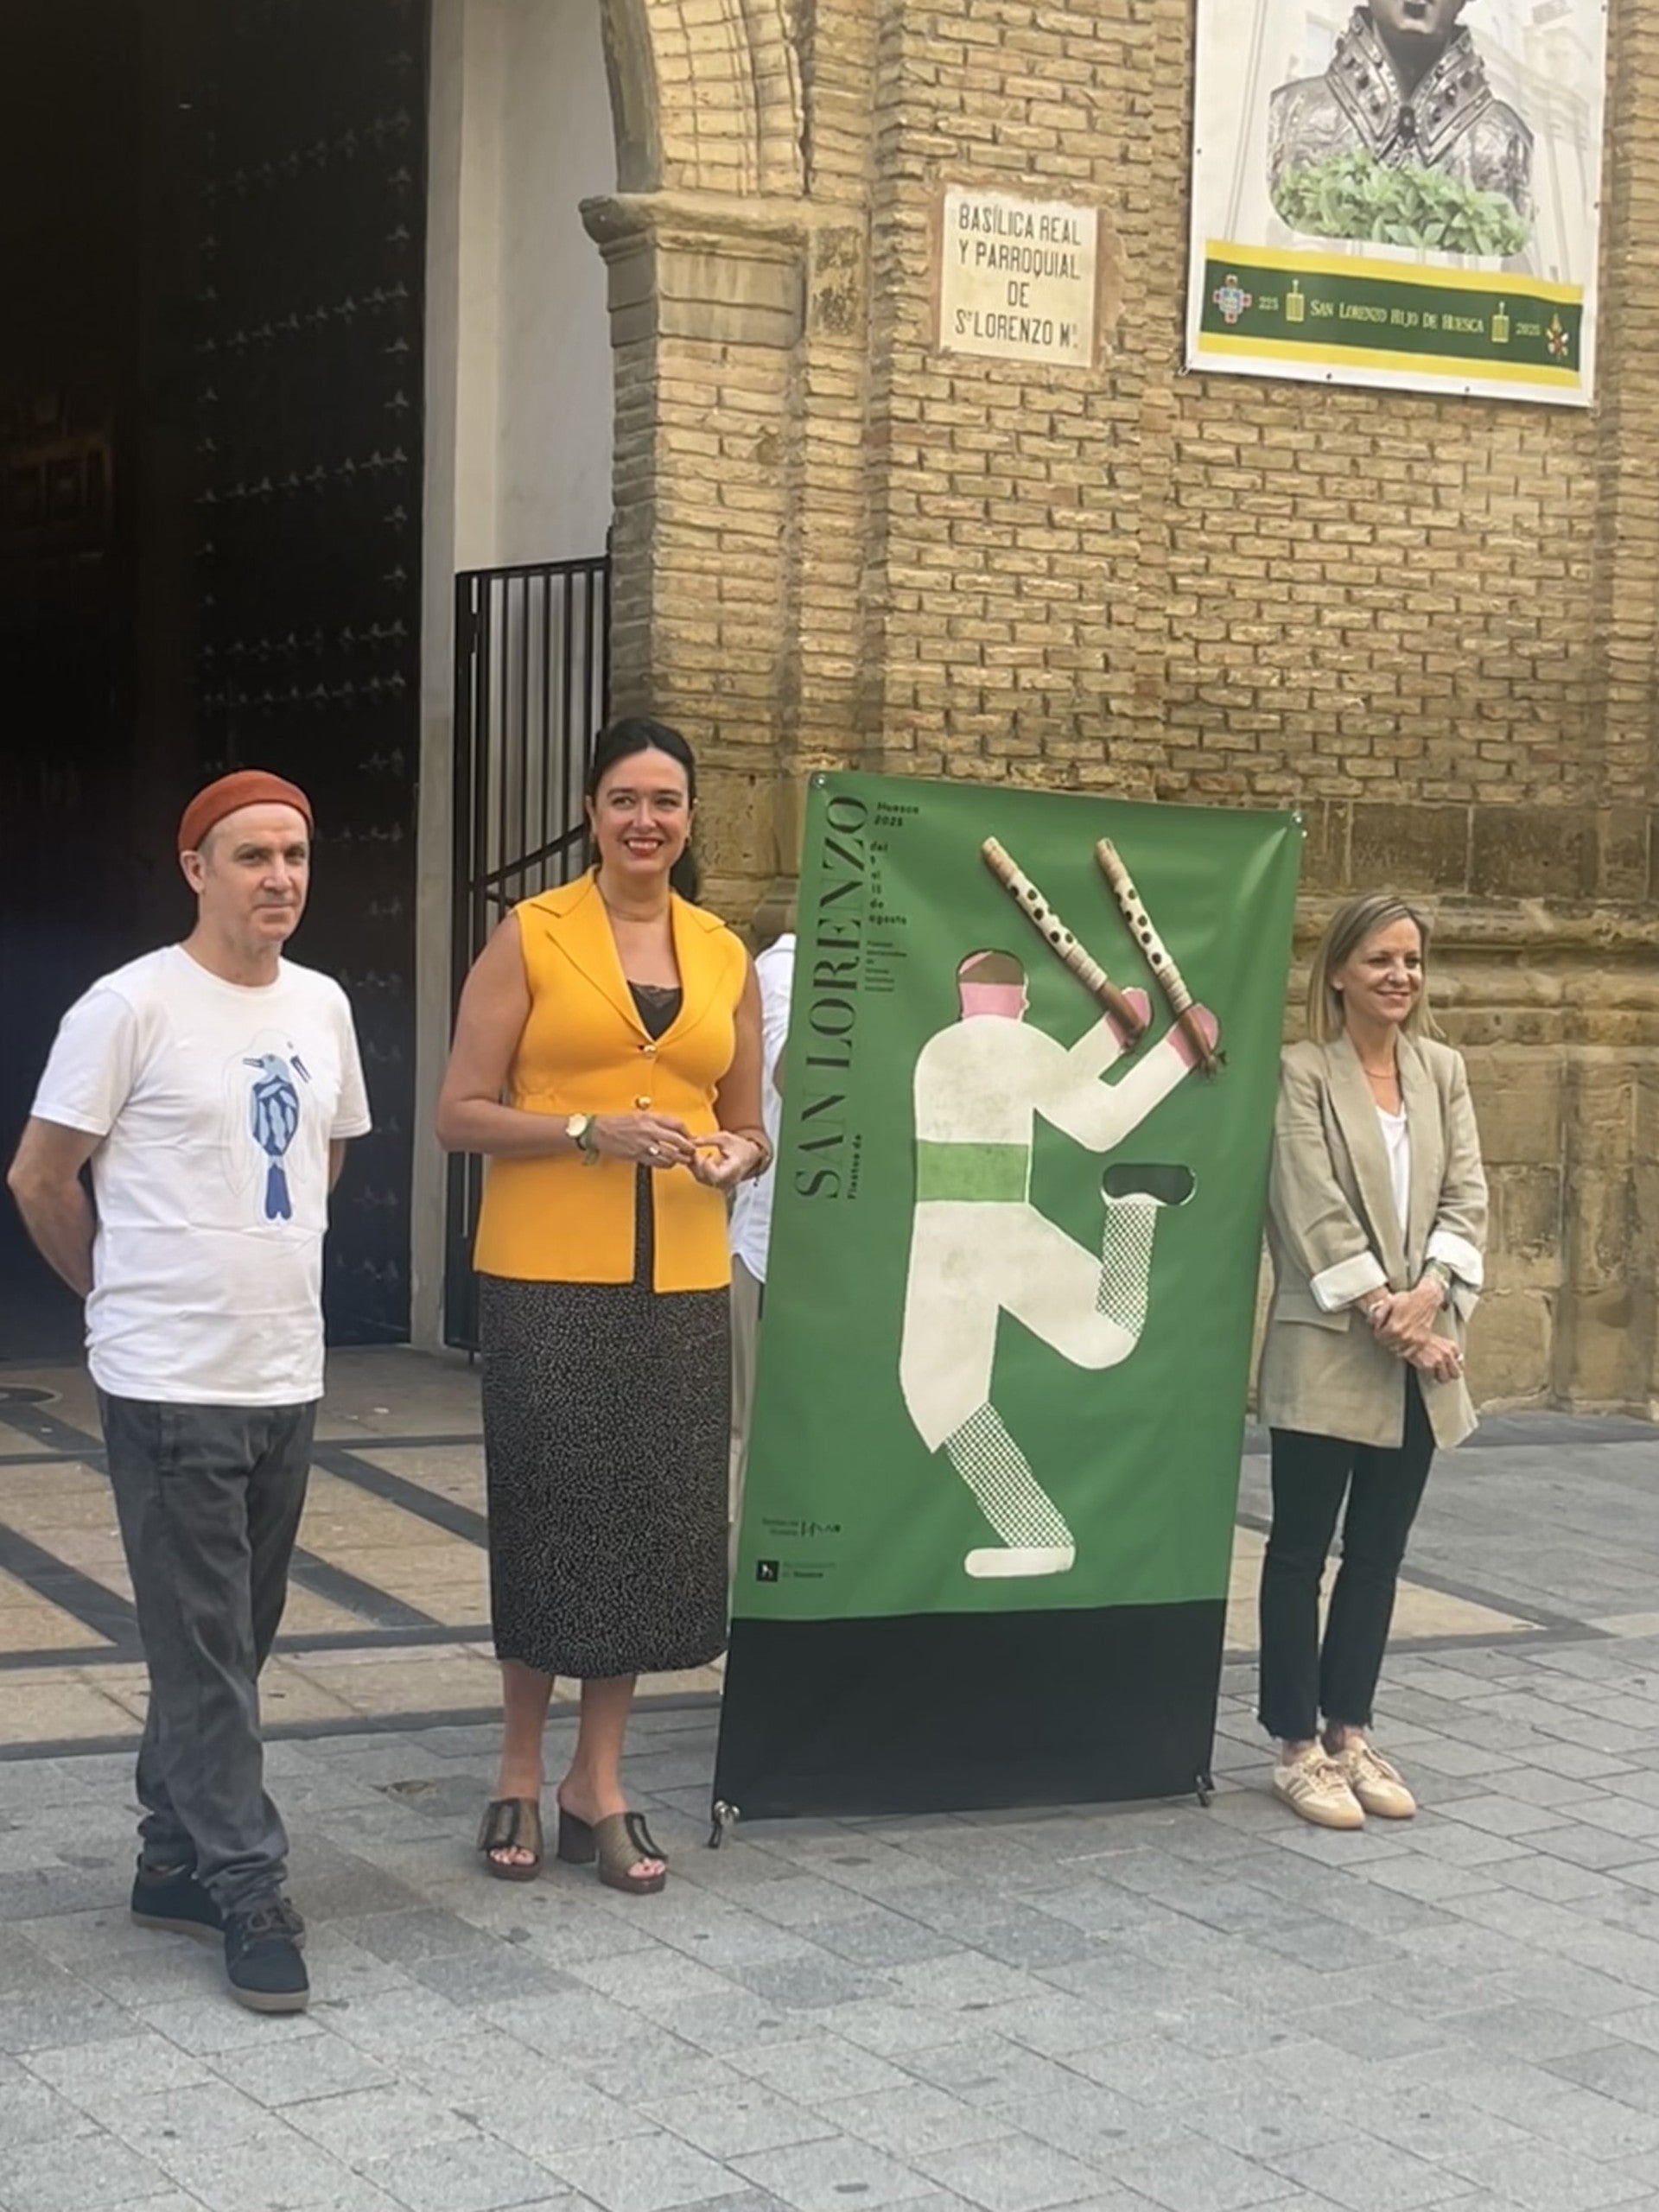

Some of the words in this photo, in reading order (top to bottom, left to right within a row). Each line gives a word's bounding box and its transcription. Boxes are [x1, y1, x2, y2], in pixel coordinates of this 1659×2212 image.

[959, 203, 1034, 239] BASÍLICA
[1039, 215, 1081, 245] REAL
[958, 238, 969, 264] Y
[975, 242, 1081, 280] PARROQUIAL
[1007, 280, 1030, 308] DE
[974, 311, 1053, 346] LORENZO
[1310, 299, 1334, 317] SAN
[1339, 302, 1388, 323] LORENZO
[1390, 308, 1419, 327] HIJO
[1422, 312, 1438, 328] DE
[1442, 314, 1484, 333] HUESCA
[804, 795, 868, 1068] LORENZO
[794, 1090, 847, 1199] SAN
